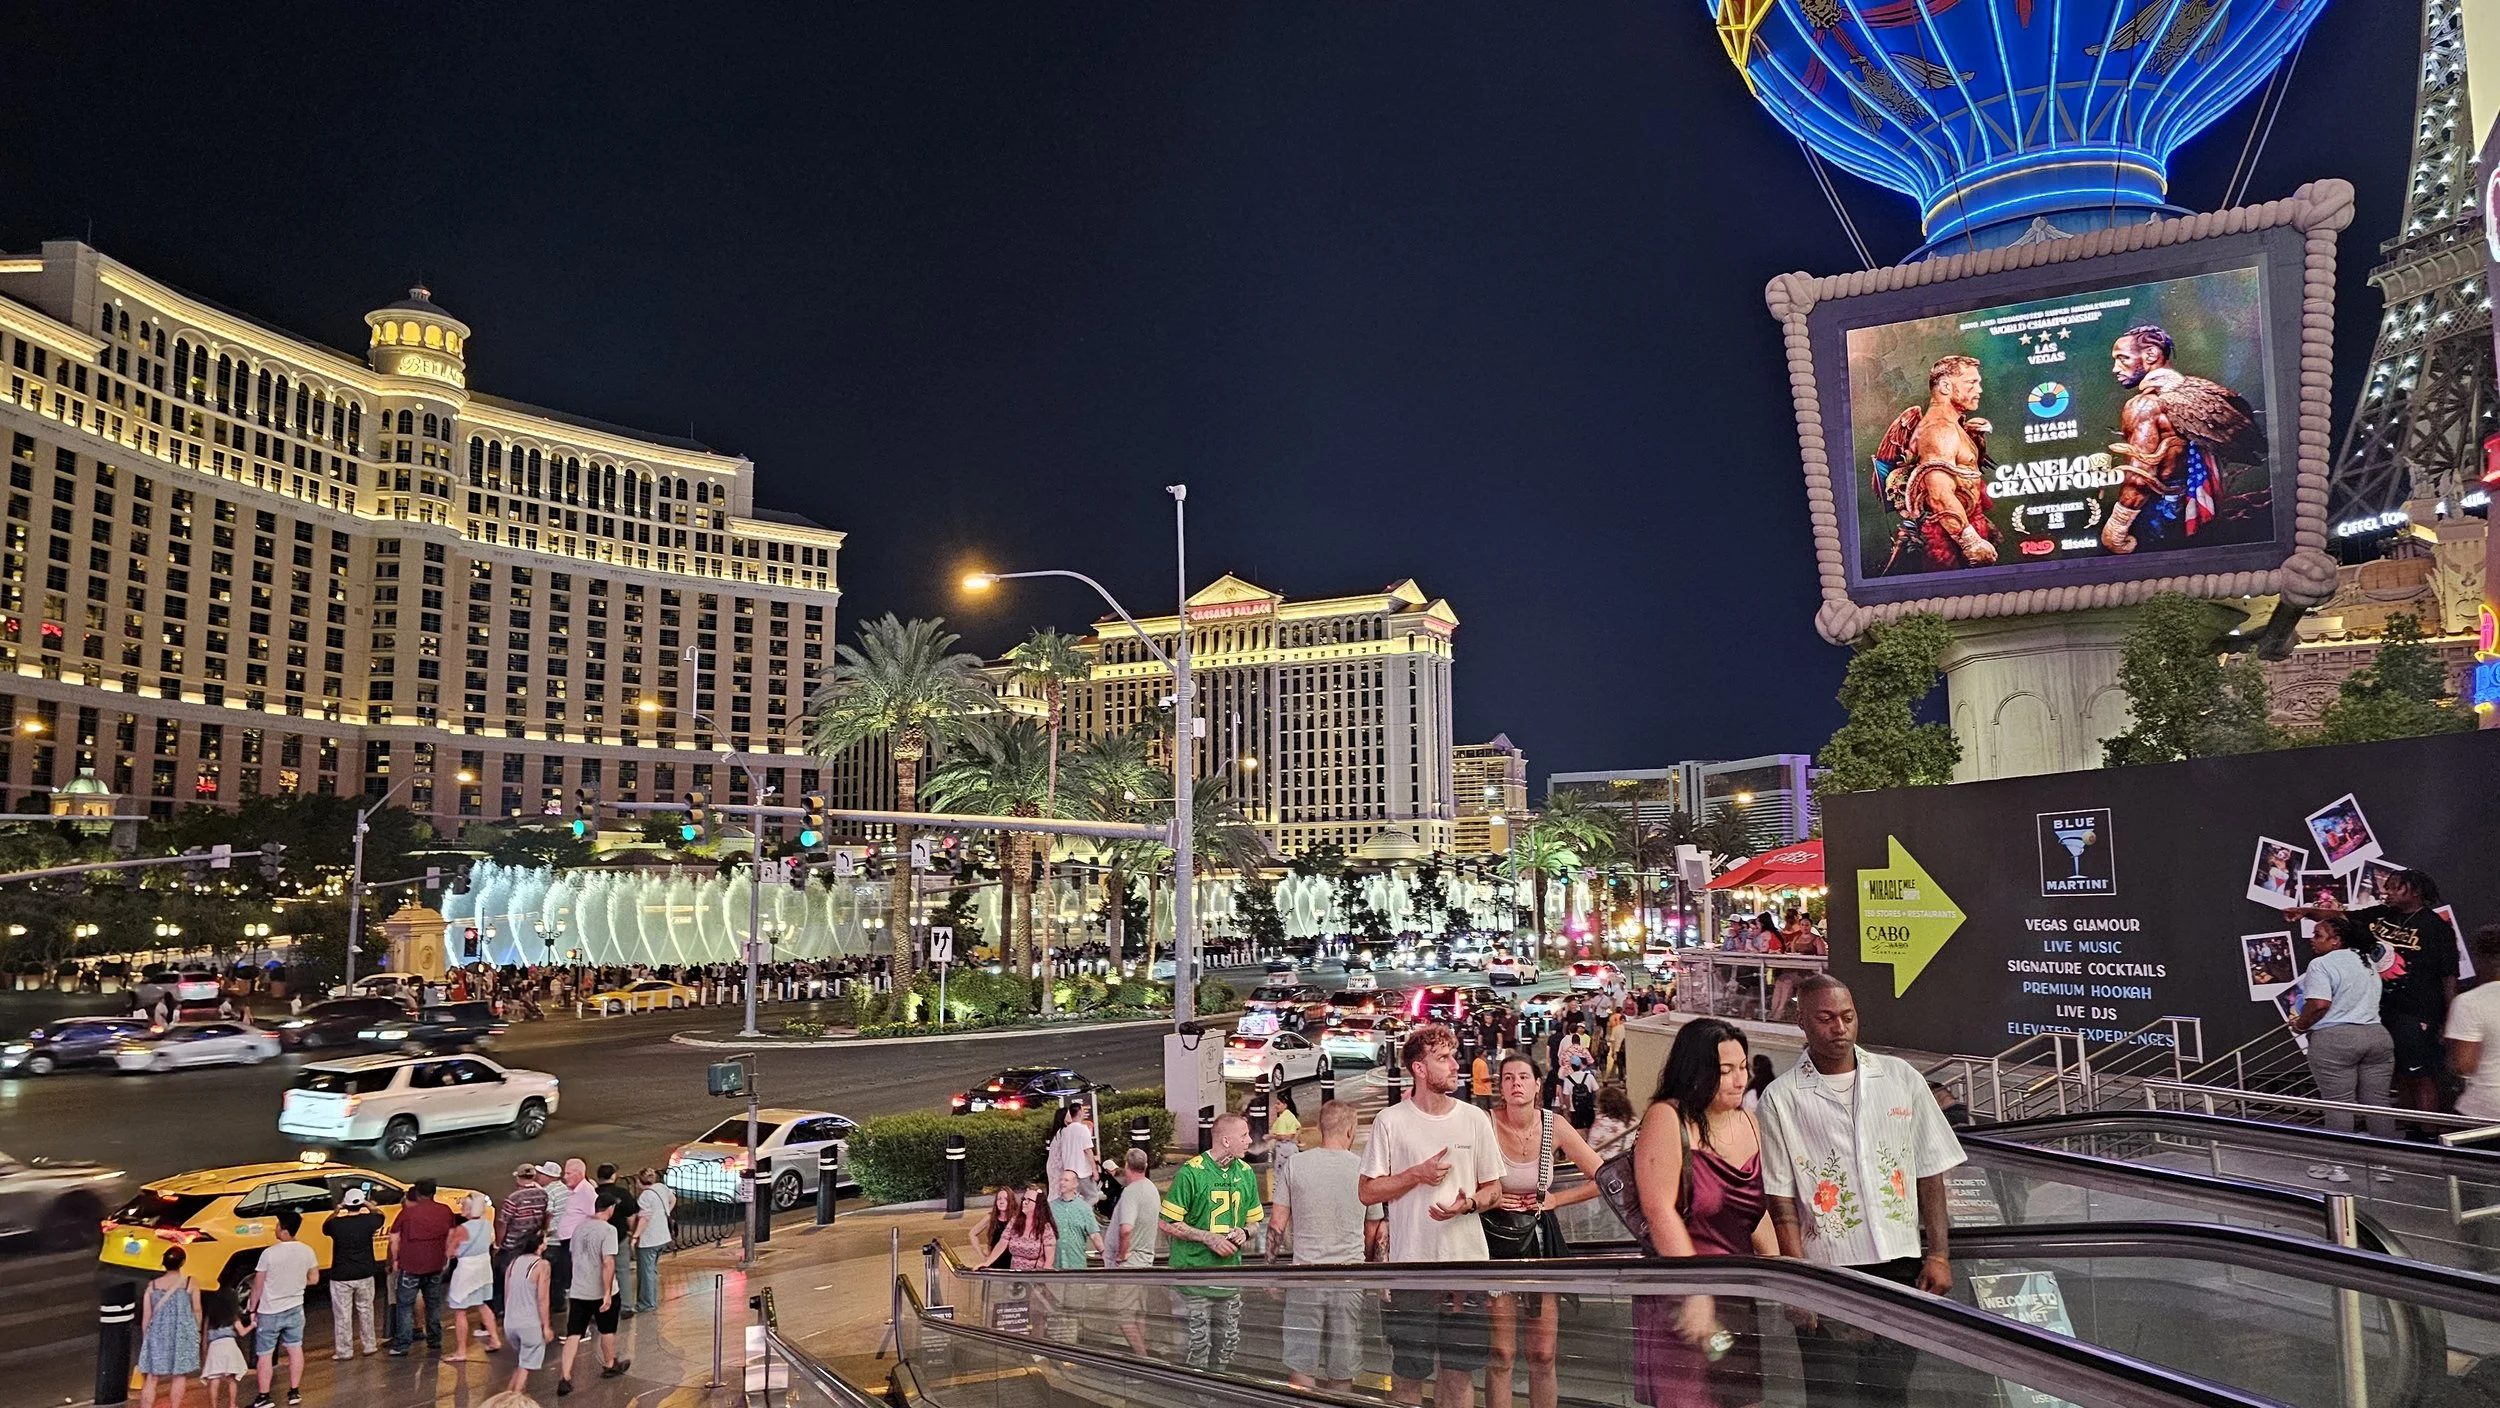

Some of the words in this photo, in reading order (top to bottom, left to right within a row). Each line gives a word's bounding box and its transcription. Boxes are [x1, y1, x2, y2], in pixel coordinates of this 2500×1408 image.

[1989, 321, 2027, 335] WORLD
[2027, 311, 2102, 330] CHAMPIONSHIP
[2034, 342, 2057, 354] LAS
[2027, 351, 2066, 365] VEGAS
[2024, 420, 2077, 434] RIYADH
[2025, 429, 2078, 443] SEASON
[1995, 455, 2090, 481] CANELO
[1986, 469, 2125, 498] CRAWFORD
[2027, 502, 2084, 515] SEPTEMBER
[2337, 517, 2381, 537] EIFFEL
[1191, 607, 1233, 620] CAESARS
[1234, 603, 1271, 616] PALACE
[2053, 817, 2095, 829] BLUE
[1869, 880, 1903, 900] MIRACLE
[1903, 880, 1915, 888] MILE
[2046, 879, 2108, 890] MARTINI
[1876, 910, 1901, 918] STORES
[1907, 910, 1956, 918] RESTAURANTS
[2025, 919, 2068, 931] VEGAS
[2073, 919, 2140, 931] GLAMOUR
[1866, 926, 1910, 941] CABO
[2044, 940, 2072, 953] LIVE
[2079, 941, 2122, 954] MUSIC
[2007, 960, 2082, 975] SIGNATURE
[2088, 962, 2166, 977] COCKTAILS
[2023, 981, 2085, 996] PREMIUM
[2091, 985, 2152, 1000] HOOKAH
[2056, 1005, 2085, 1018] LIVE
[2092, 1006, 2117, 1020] DJS
[1210, 1190, 1241, 1233] 21
[1983, 1294, 2038, 1308] WELCOME
[2039, 1293, 2058, 1305] TO
